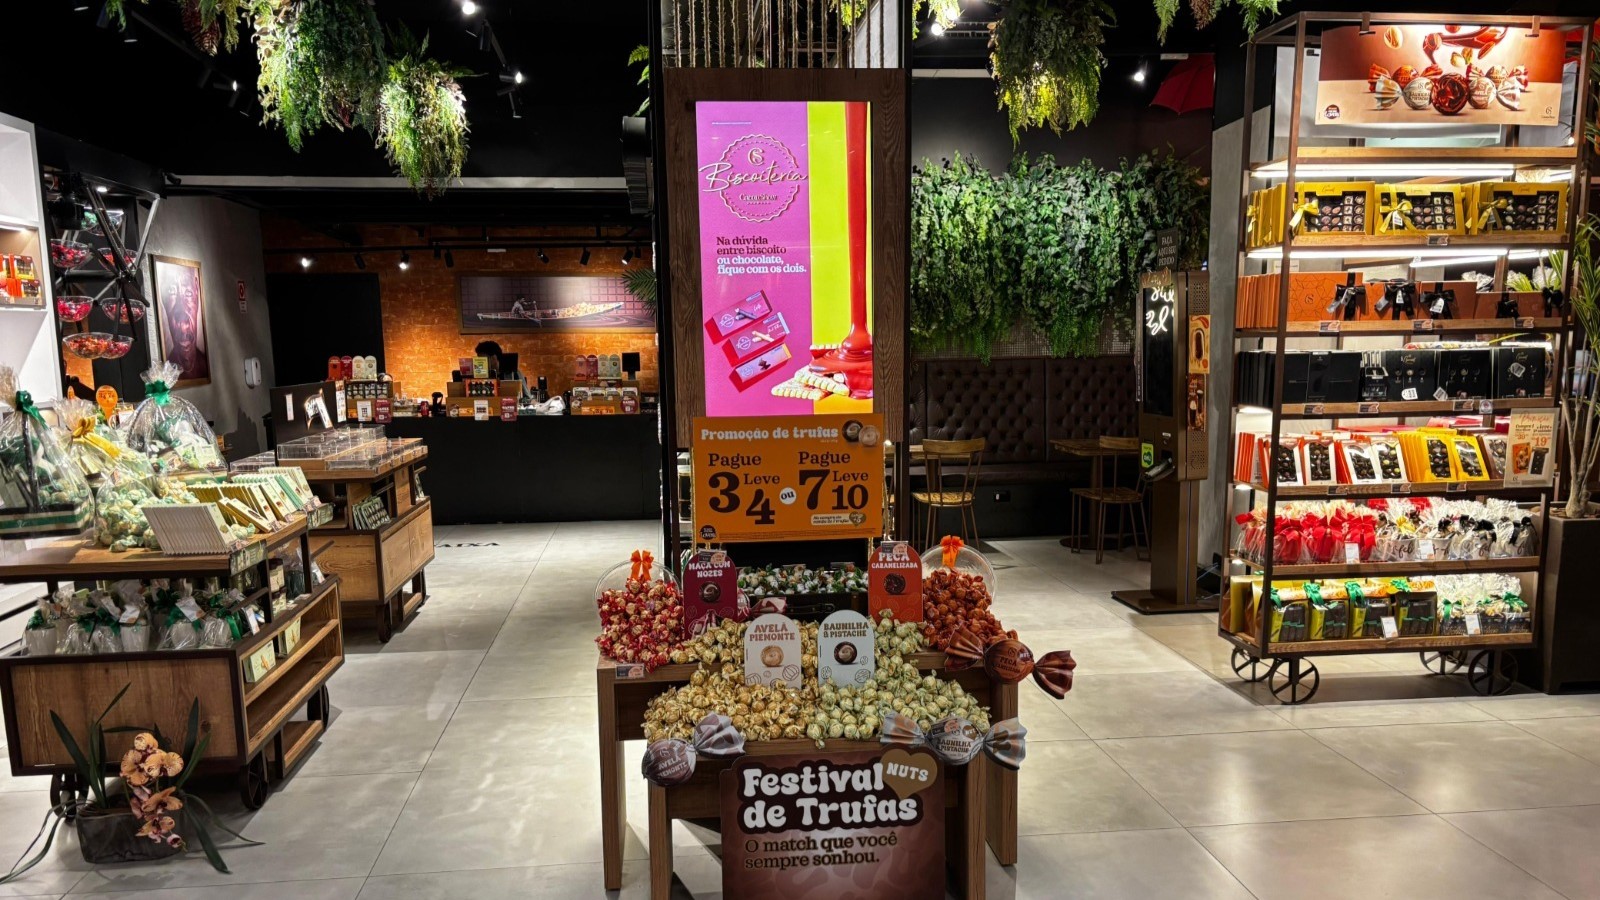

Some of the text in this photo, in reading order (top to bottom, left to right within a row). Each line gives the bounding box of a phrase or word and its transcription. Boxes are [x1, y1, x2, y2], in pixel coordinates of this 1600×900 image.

[699, 160, 808, 192] Biscoiteria
[716, 235, 768, 246] Na dúvida
[717, 245, 786, 255] entre biscoito
[717, 255, 784, 265] ou chocolate,
[717, 265, 745, 276] fique
[746, 266, 769, 274] com
[783, 263, 807, 273] dois.
[701, 426, 839, 442] Promoção de trufas
[708, 453, 762, 469] Pague
[798, 451, 850, 467] Pague
[743, 473, 780, 485] Leve
[832, 470, 869, 482] Leve
[708, 471, 741, 513] 3
[780, 491, 794, 500] ou
[799, 469, 831, 510] 7
[832, 483, 869, 510] 10
[745, 488, 775, 525] 4
[697, 570, 723, 578] NOZES
[753, 621, 788, 633] AVELÃ
[823, 621, 869, 631] BAUNILHA
[830, 629, 867, 638] PISTACHE
[749, 632, 796, 642] PIEMONTE
[743, 763, 884, 797] Festival
[886, 762, 929, 782] NUTS
[743, 795, 918, 828] de Trufas
[745, 831, 898, 853] O match que você
[745, 851, 880, 870] sempre sonhou.
